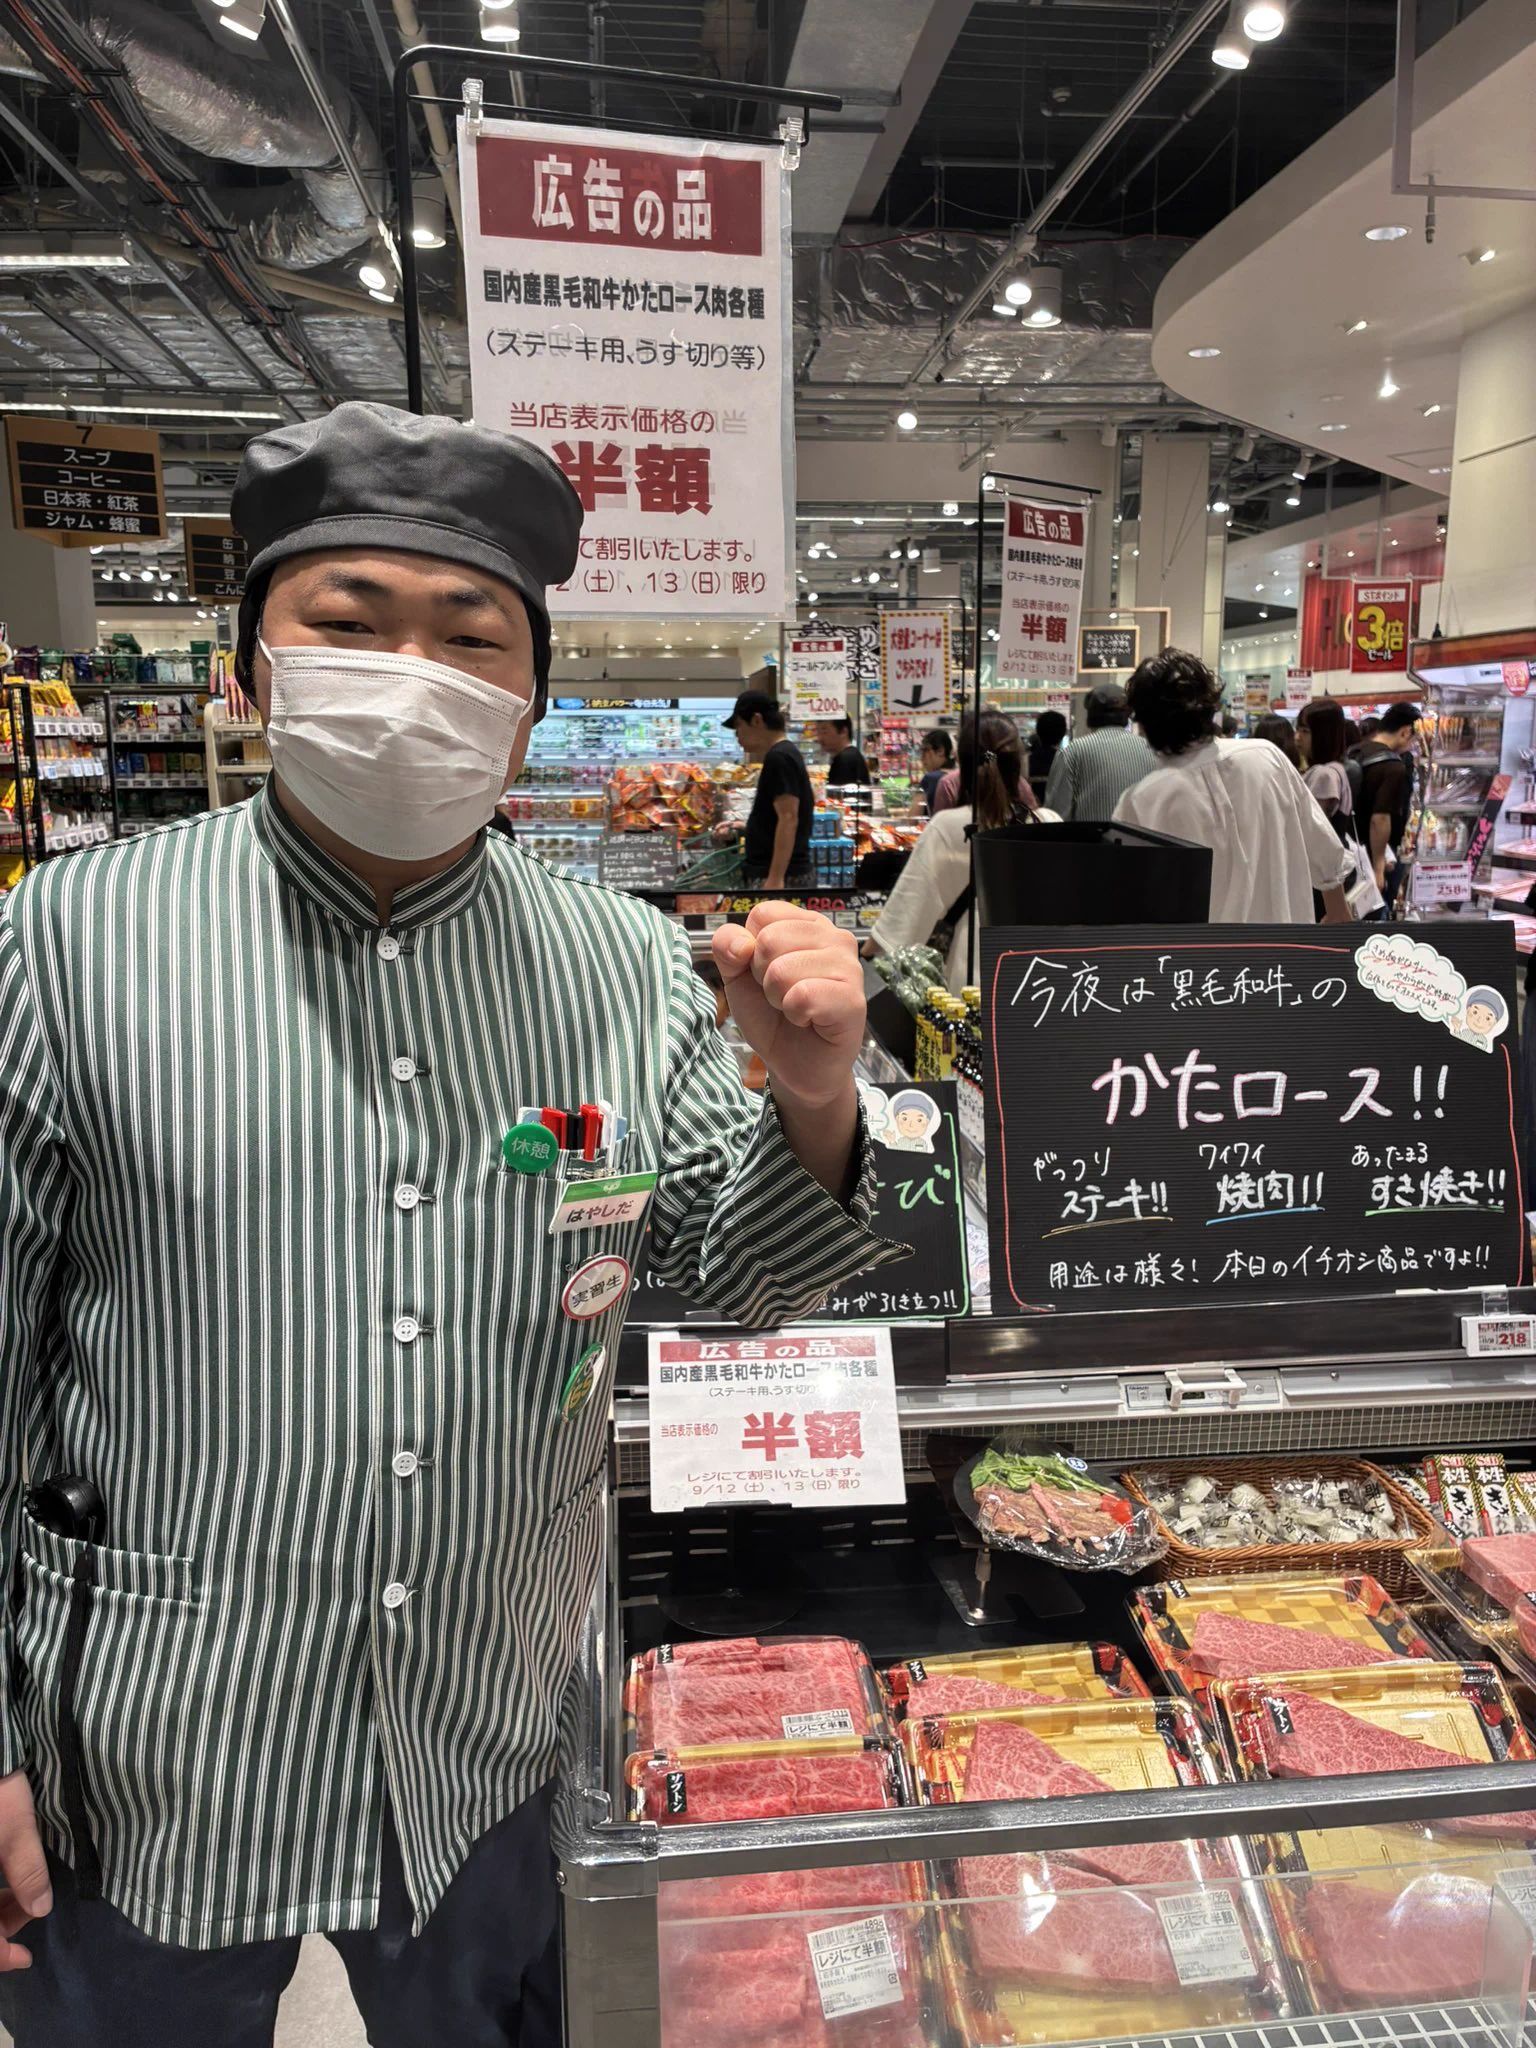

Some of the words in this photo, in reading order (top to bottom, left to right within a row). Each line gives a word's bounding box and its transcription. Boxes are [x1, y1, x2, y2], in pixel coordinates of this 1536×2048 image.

[532, 154, 713, 241] 広告の品
[483, 268, 766, 320] 国内産黒毛和牛かたロース肉各種
[510, 402, 715, 434] 当店表示価格の
[75, 425, 93, 444] 7
[63, 448, 111, 465] スープ
[58, 470, 121, 488] コーヒー
[551, 440, 713, 516] 半額
[44, 490, 139, 512] 日本茶・紅茶
[45, 511, 141, 534] ジャム・蜂蜜
[1022, 508, 1072, 541] 広告の品
[1021, 613, 1068, 644] 半額
[1357, 606, 1404, 651] 3倍
[1367, 649, 1393, 661] セール
[511, 1136, 550, 1161] 休憩
[1199, 1143, 1266, 1169] ワイワイ
[1352, 1142, 1430, 1168] あったまる
[1034, 1147, 1110, 1182] がっつり
[566, 1201, 633, 1224] はやしだ
[572, 1274, 623, 1307] 実習生
[699, 1339, 836, 1359] 広告の品
[1499, 1332, 1526, 1344] 218
[661, 1422, 718, 1437] 当店表示価格の
[742, 1411, 864, 1461] 半額
[1441, 1467, 1470, 1483] 本生
[1475, 1466, 1506, 1483] 本生
[790, 1720, 848, 1733] レジにて半額
[1168, 1911, 1235, 1930] レジにて半額
[818, 1940, 888, 1968] レジにて半額
